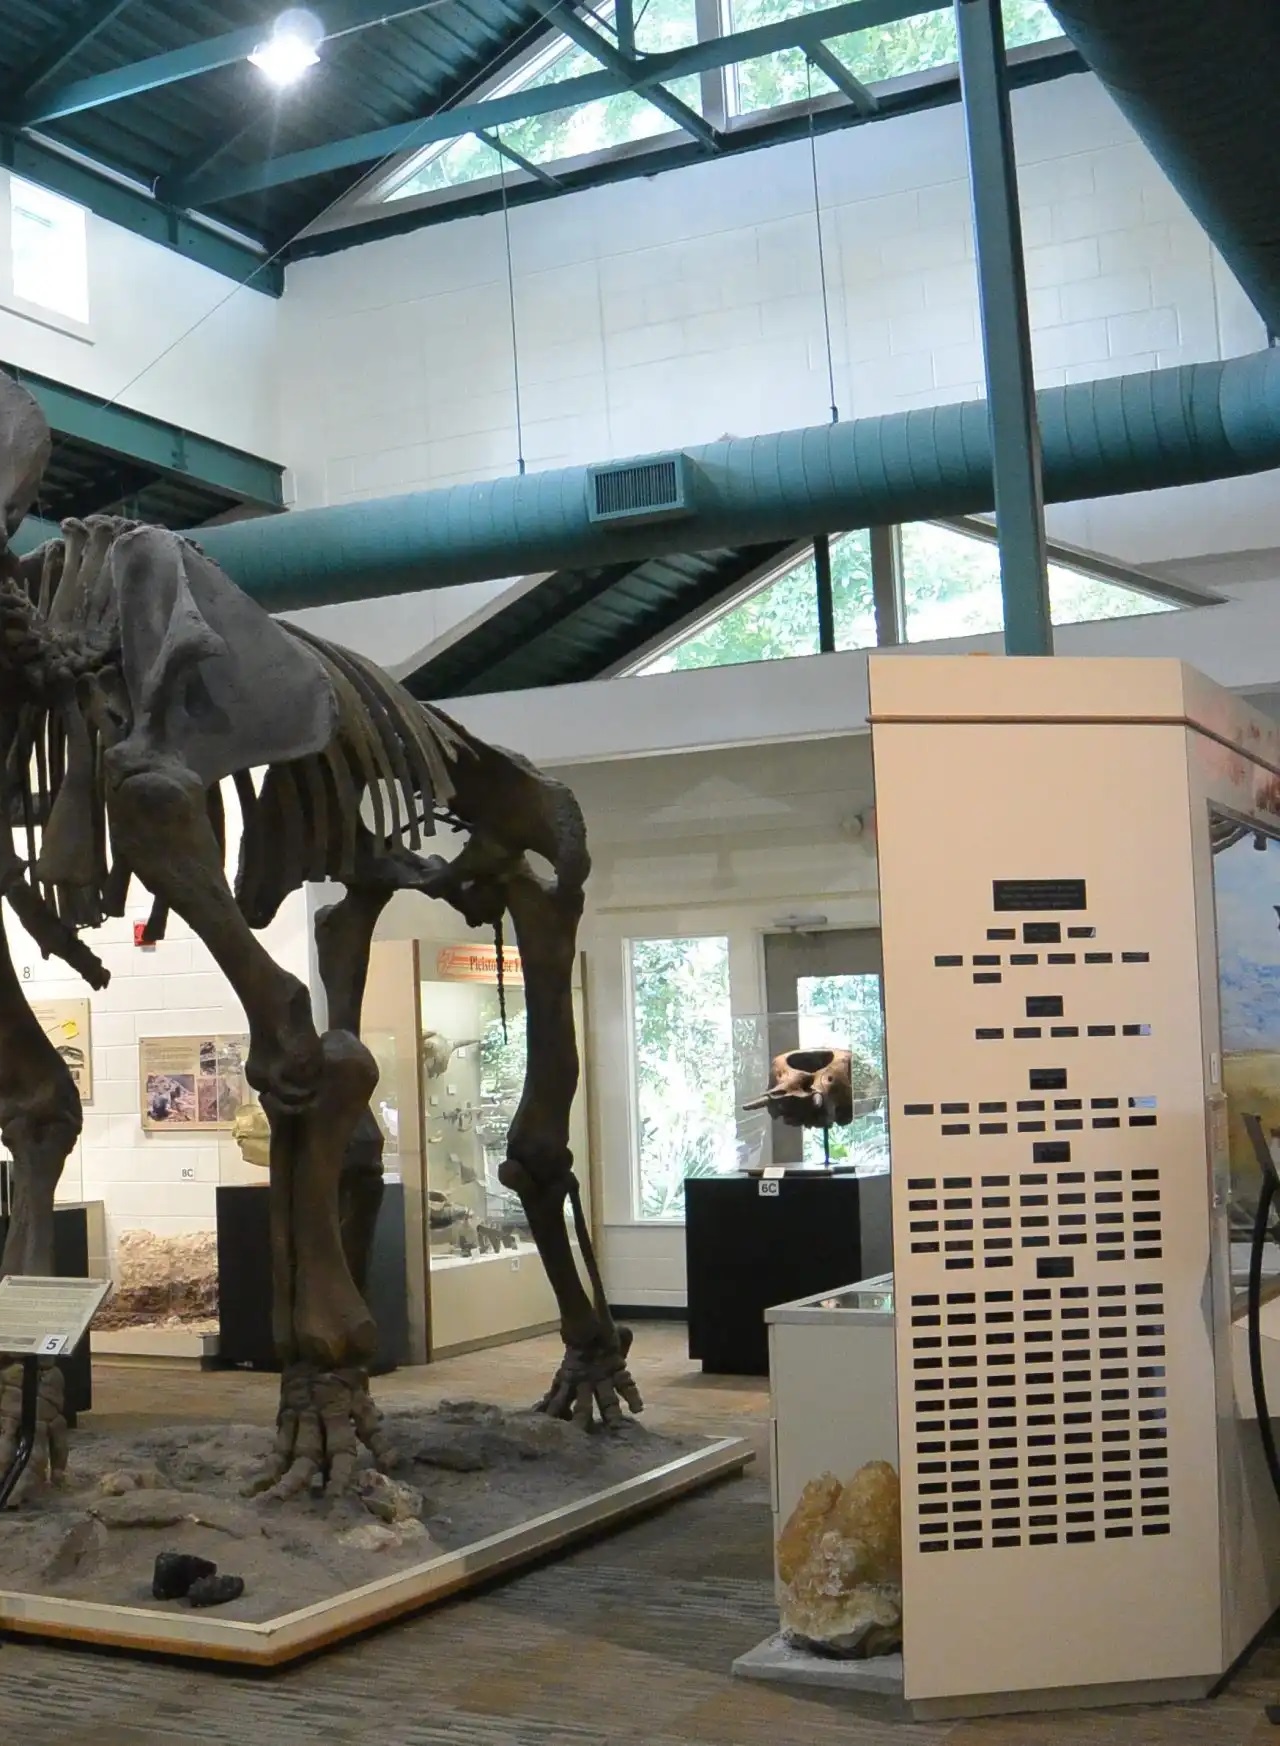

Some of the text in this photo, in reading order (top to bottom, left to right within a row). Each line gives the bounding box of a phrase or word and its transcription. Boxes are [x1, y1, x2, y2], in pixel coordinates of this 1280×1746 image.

[470, 955, 512, 972] Pleistone
[22, 966, 31, 979] 8
[761, 1182, 777, 1194] 6C
[46, 1338, 60, 1351] 5
